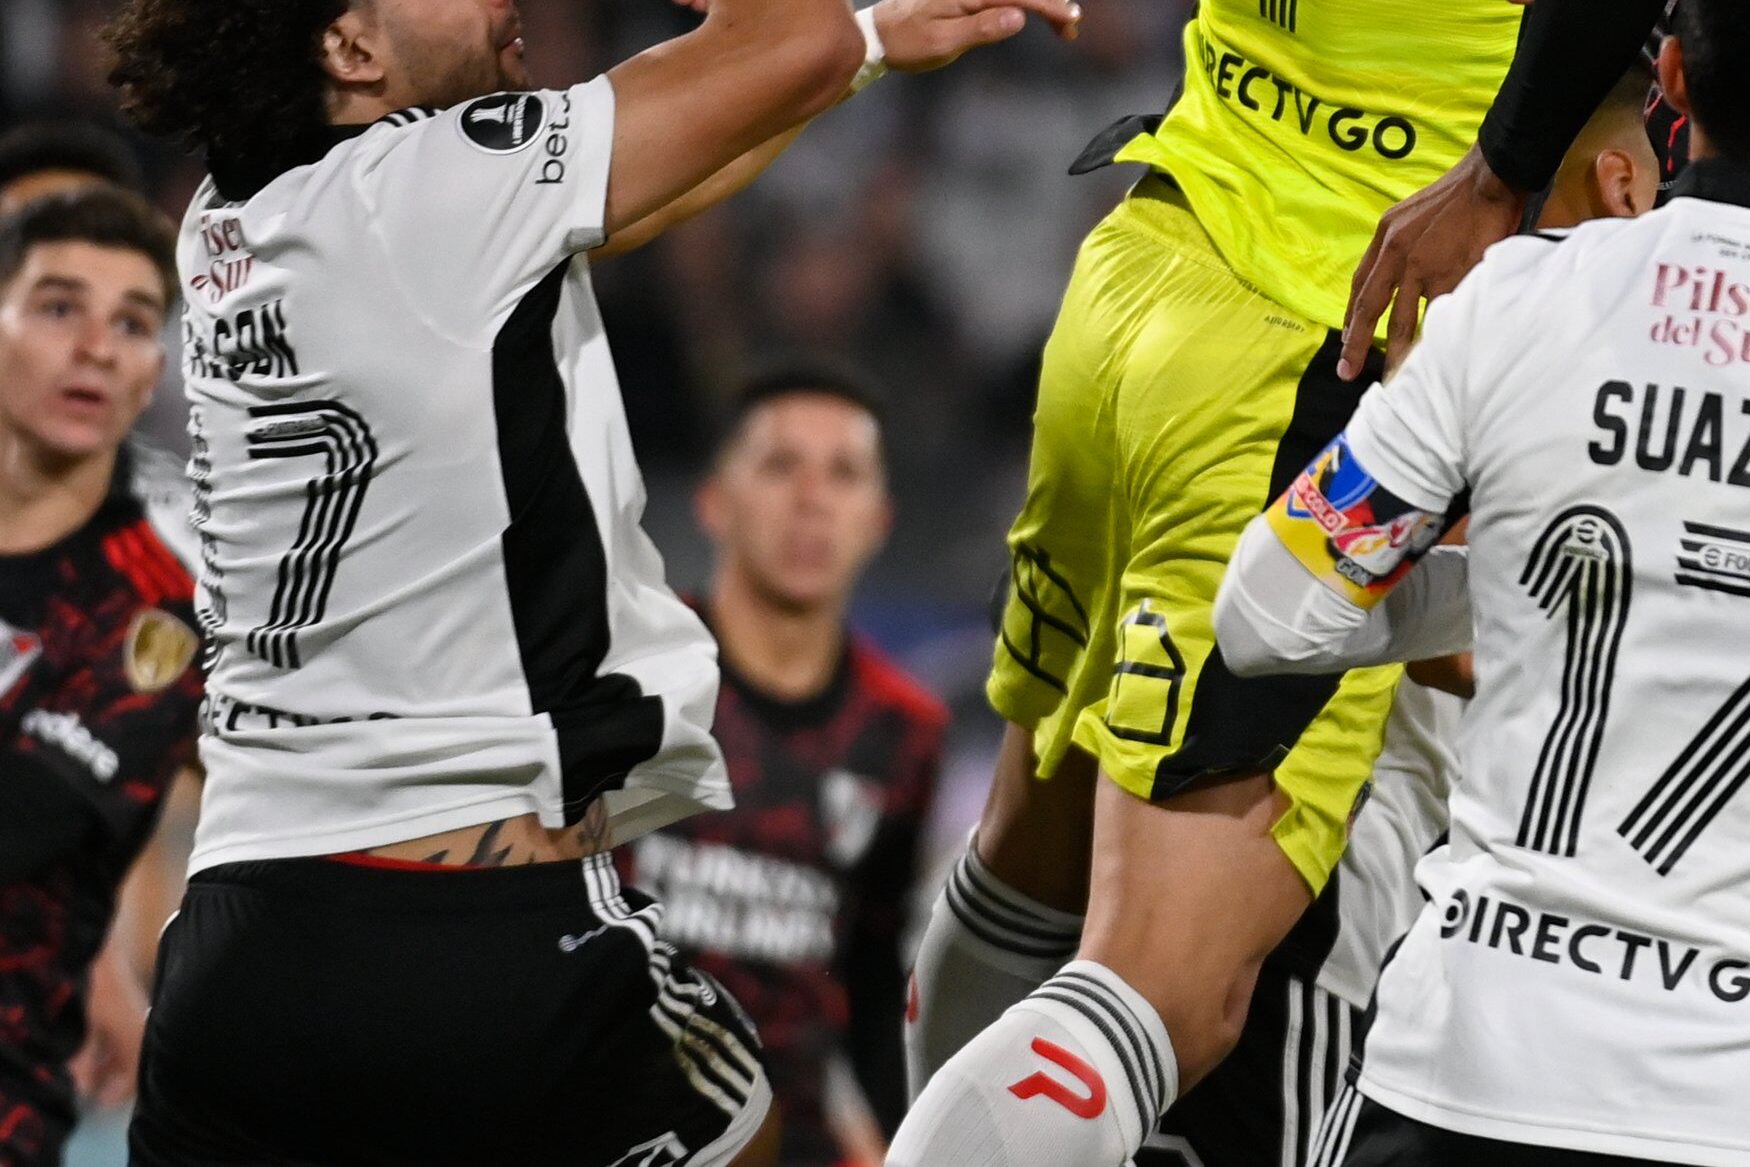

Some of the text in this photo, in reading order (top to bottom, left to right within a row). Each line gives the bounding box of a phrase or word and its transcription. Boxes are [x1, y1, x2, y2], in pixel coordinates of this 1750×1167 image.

[1199, 34, 1417, 160] RECTV GO
[1649, 315, 1702, 349] del
[1440, 887, 1699, 992] DIRECTV
